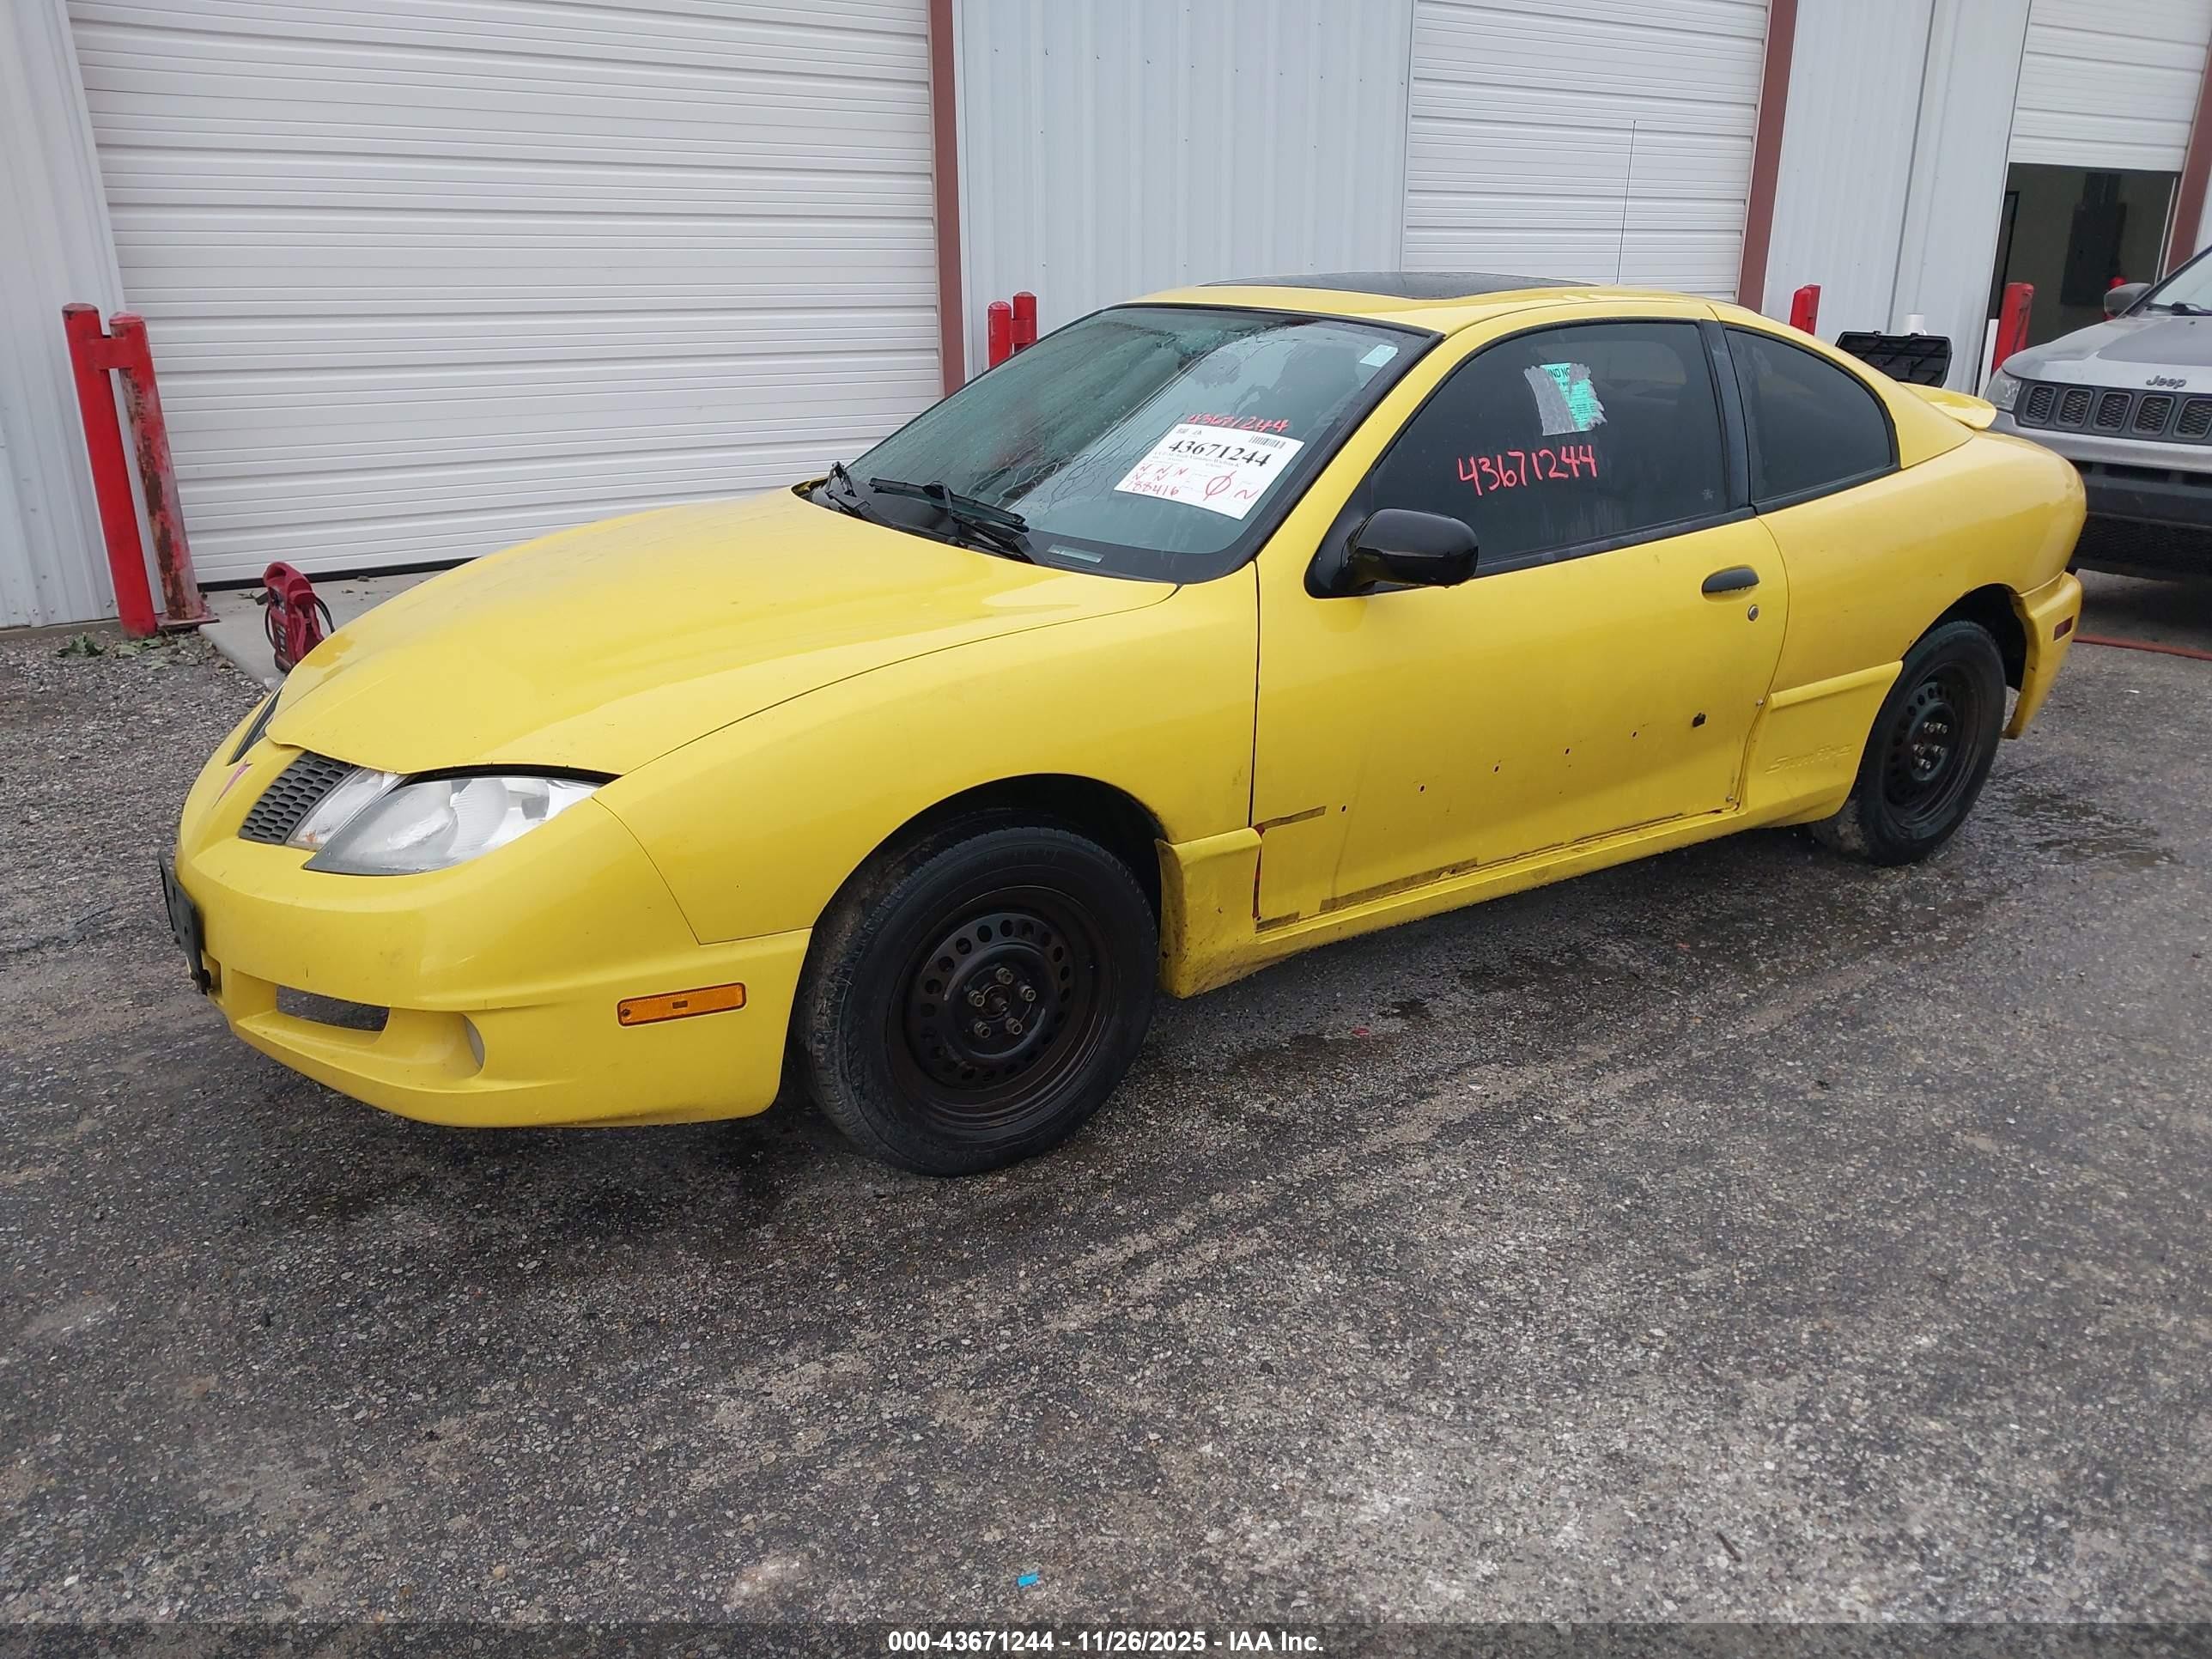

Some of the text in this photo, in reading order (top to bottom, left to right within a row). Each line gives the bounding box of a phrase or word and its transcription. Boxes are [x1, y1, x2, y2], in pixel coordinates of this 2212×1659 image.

[2146, 375, 2187, 389] Jeep
[1187, 412, 1290, 434] 43671244
[1168, 440, 1272, 467] 43671244
[1457, 445, 1598, 496] 43671244
